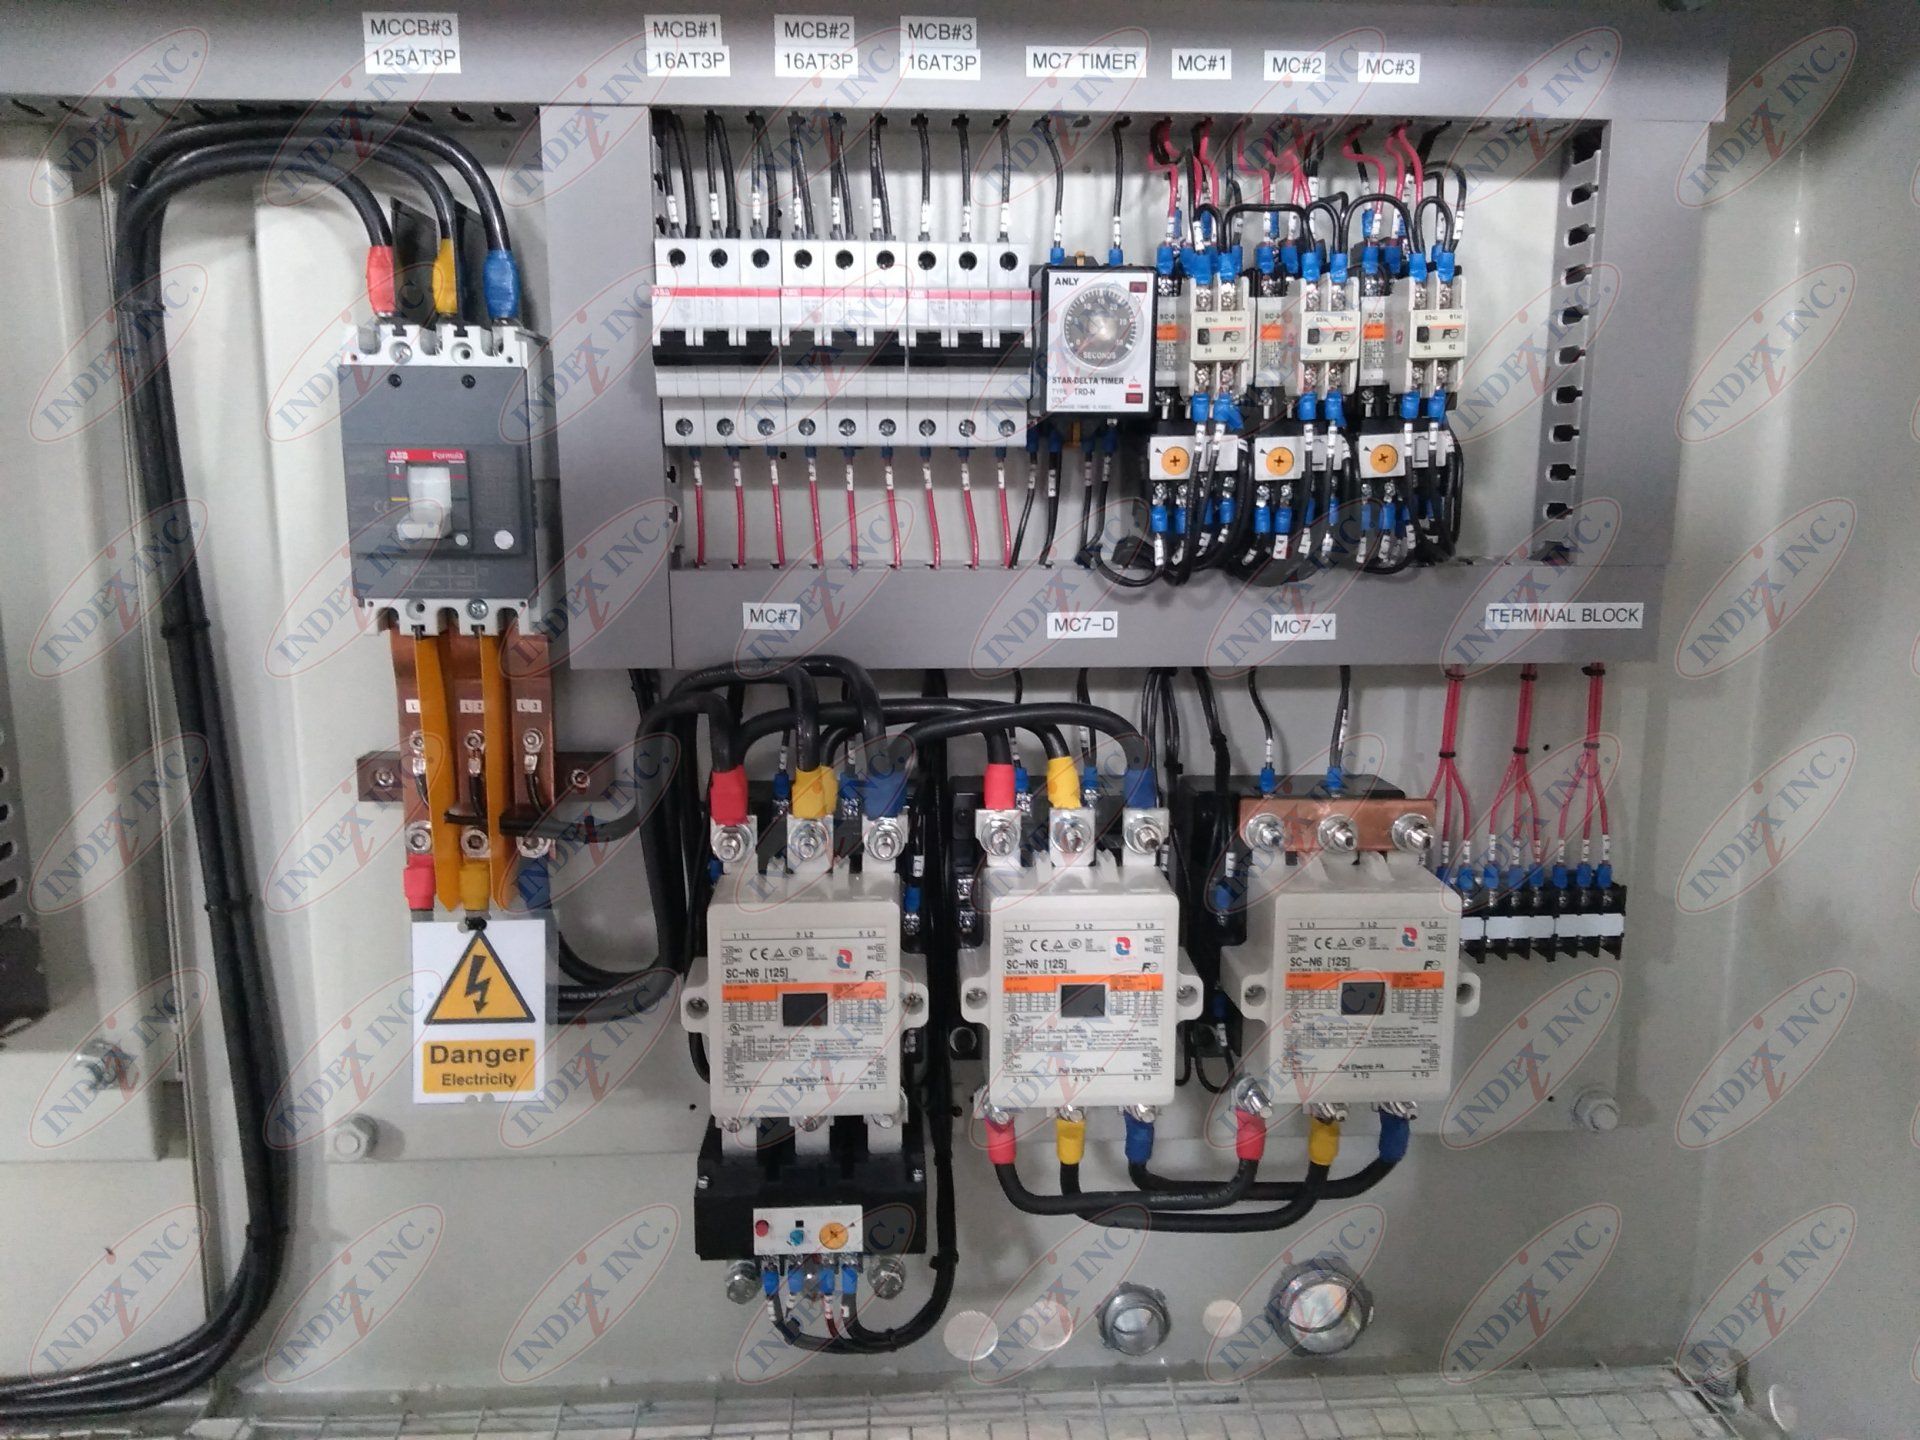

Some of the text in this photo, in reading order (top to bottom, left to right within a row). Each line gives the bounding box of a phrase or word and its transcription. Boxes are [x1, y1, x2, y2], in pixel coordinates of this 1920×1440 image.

[370, 18, 453, 36] MCCB#3
[653, 21, 717, 38] MCB#1
[784, 21, 850, 39] MCB#2
[908, 23, 973, 40] MCB#3
[373, 49, 456, 66] 125AT3P
[656, 52, 725, 69] 16AT3P
[785, 53, 853, 70] 16AT3P
[909, 54, 977, 71] 16AT3P
[1033, 53, 1137, 70] MC7 TIMER
[1178, 55, 1226, 71] MC#1
[1272, 57, 1322, 74] MC#2
[1366, 59, 1415, 76] MC#3
[1055, 278, 1079, 286] ANLY
[389, 451, 464, 460] ABB Formula
[749, 608, 798, 624] MC#7
[1054, 616, 1115, 632] MC7-D
[1489, 608, 1639, 623] TERMINAL BLOCK
[1274, 619, 1332, 635] MC7-Y
[1006, 959, 1067, 970] SC-N6 [125]
[1290, 957, 1350, 967] SC-N6 [125]
[726, 967, 788, 979] SC-N6 [125]
[430, 1045, 530, 1068] Danger
[441, 1072, 517, 1088] Electricity
